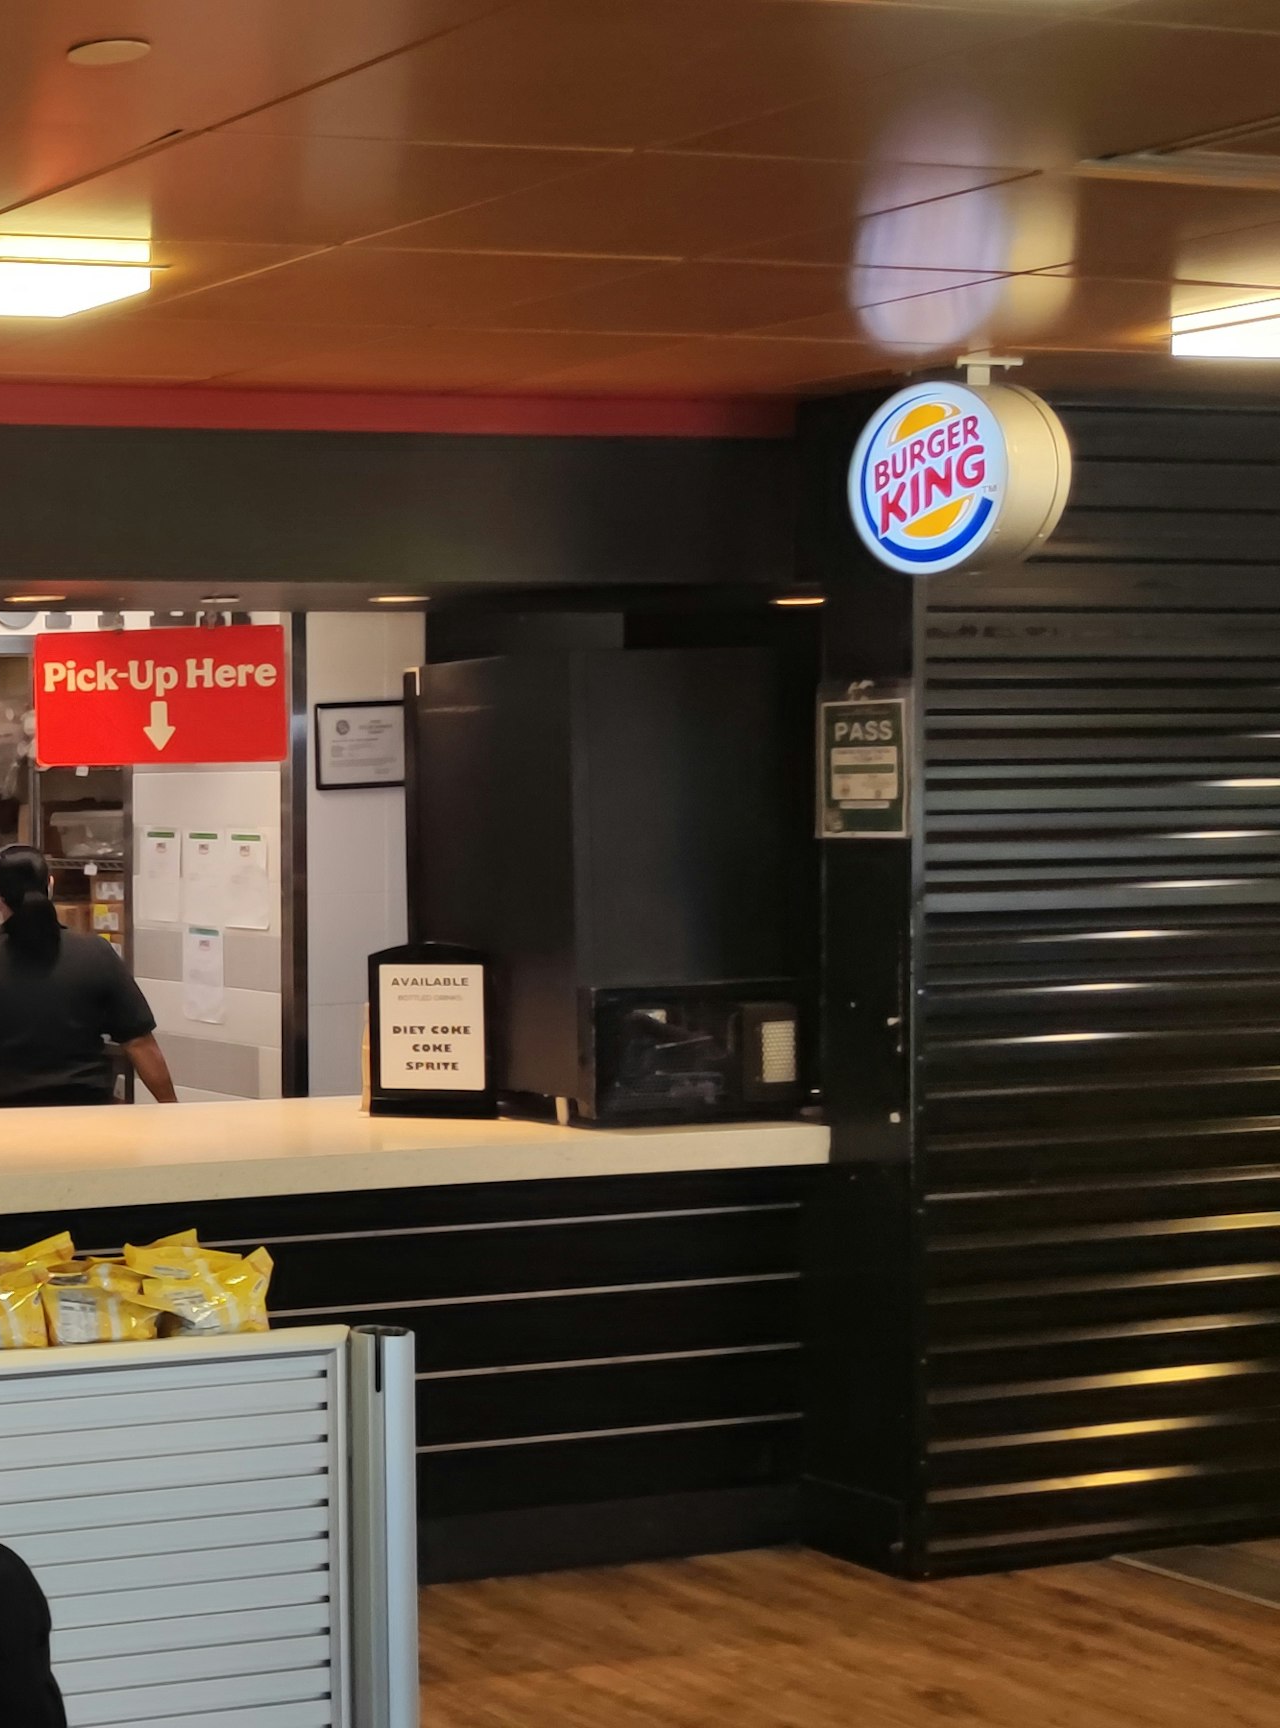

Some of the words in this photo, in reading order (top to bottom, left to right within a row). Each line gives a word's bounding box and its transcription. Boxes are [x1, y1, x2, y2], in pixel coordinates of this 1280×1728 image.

[874, 414, 981, 494] BURGER
[880, 444, 986, 537] KING
[42, 658, 179, 698] Pick-Up
[185, 658, 278, 689] Here
[834, 720, 894, 741] PASS
[391, 977, 470, 987] AVAILABLE
[392, 1025, 426, 1035] DIET
[430, 1025, 472, 1035] COKE
[411, 1043, 453, 1053] COKE
[405, 1061, 460, 1071] SPRITE
